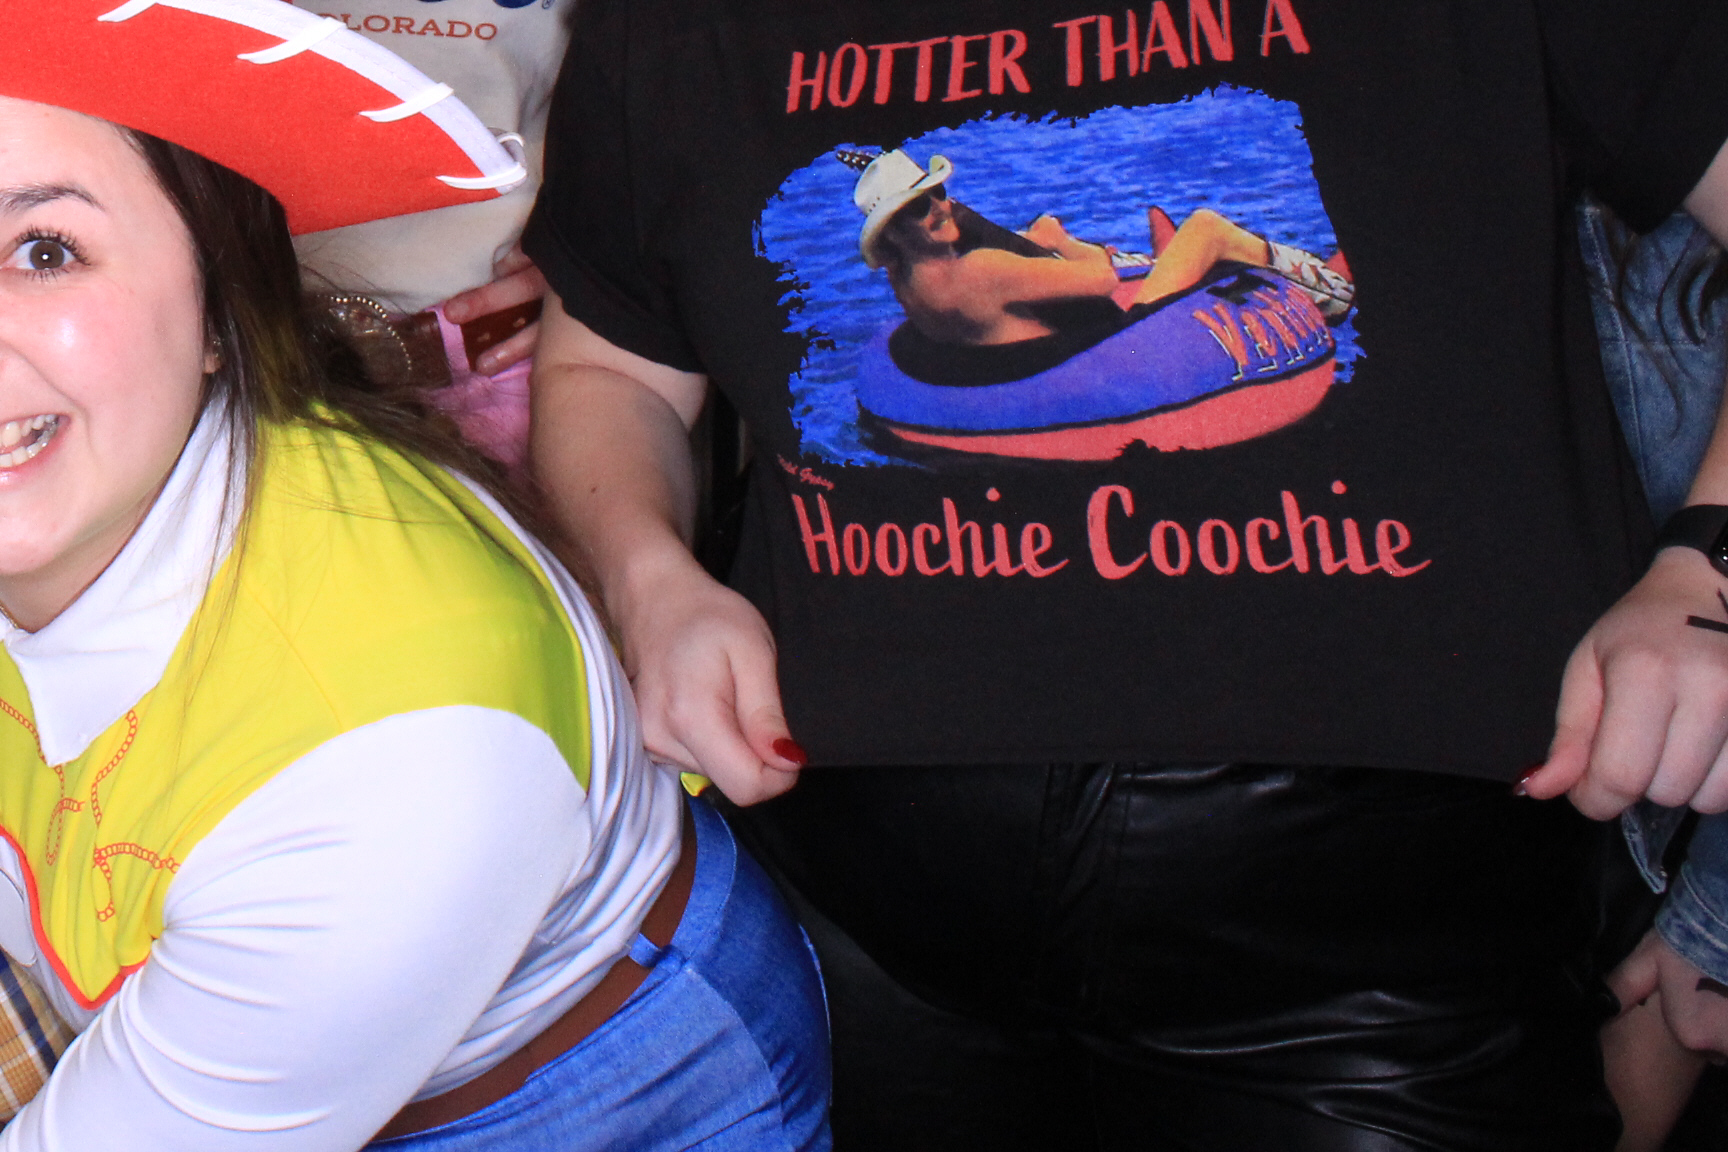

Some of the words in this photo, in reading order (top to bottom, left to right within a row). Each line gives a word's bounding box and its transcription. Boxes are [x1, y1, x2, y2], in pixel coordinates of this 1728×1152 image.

[317, 13, 498, 40] LORADO
[786, 29, 1030, 113] HOTTER
[791, 488, 1068, 576] Hoochie
[1087, 480, 1432, 579] Coochie
